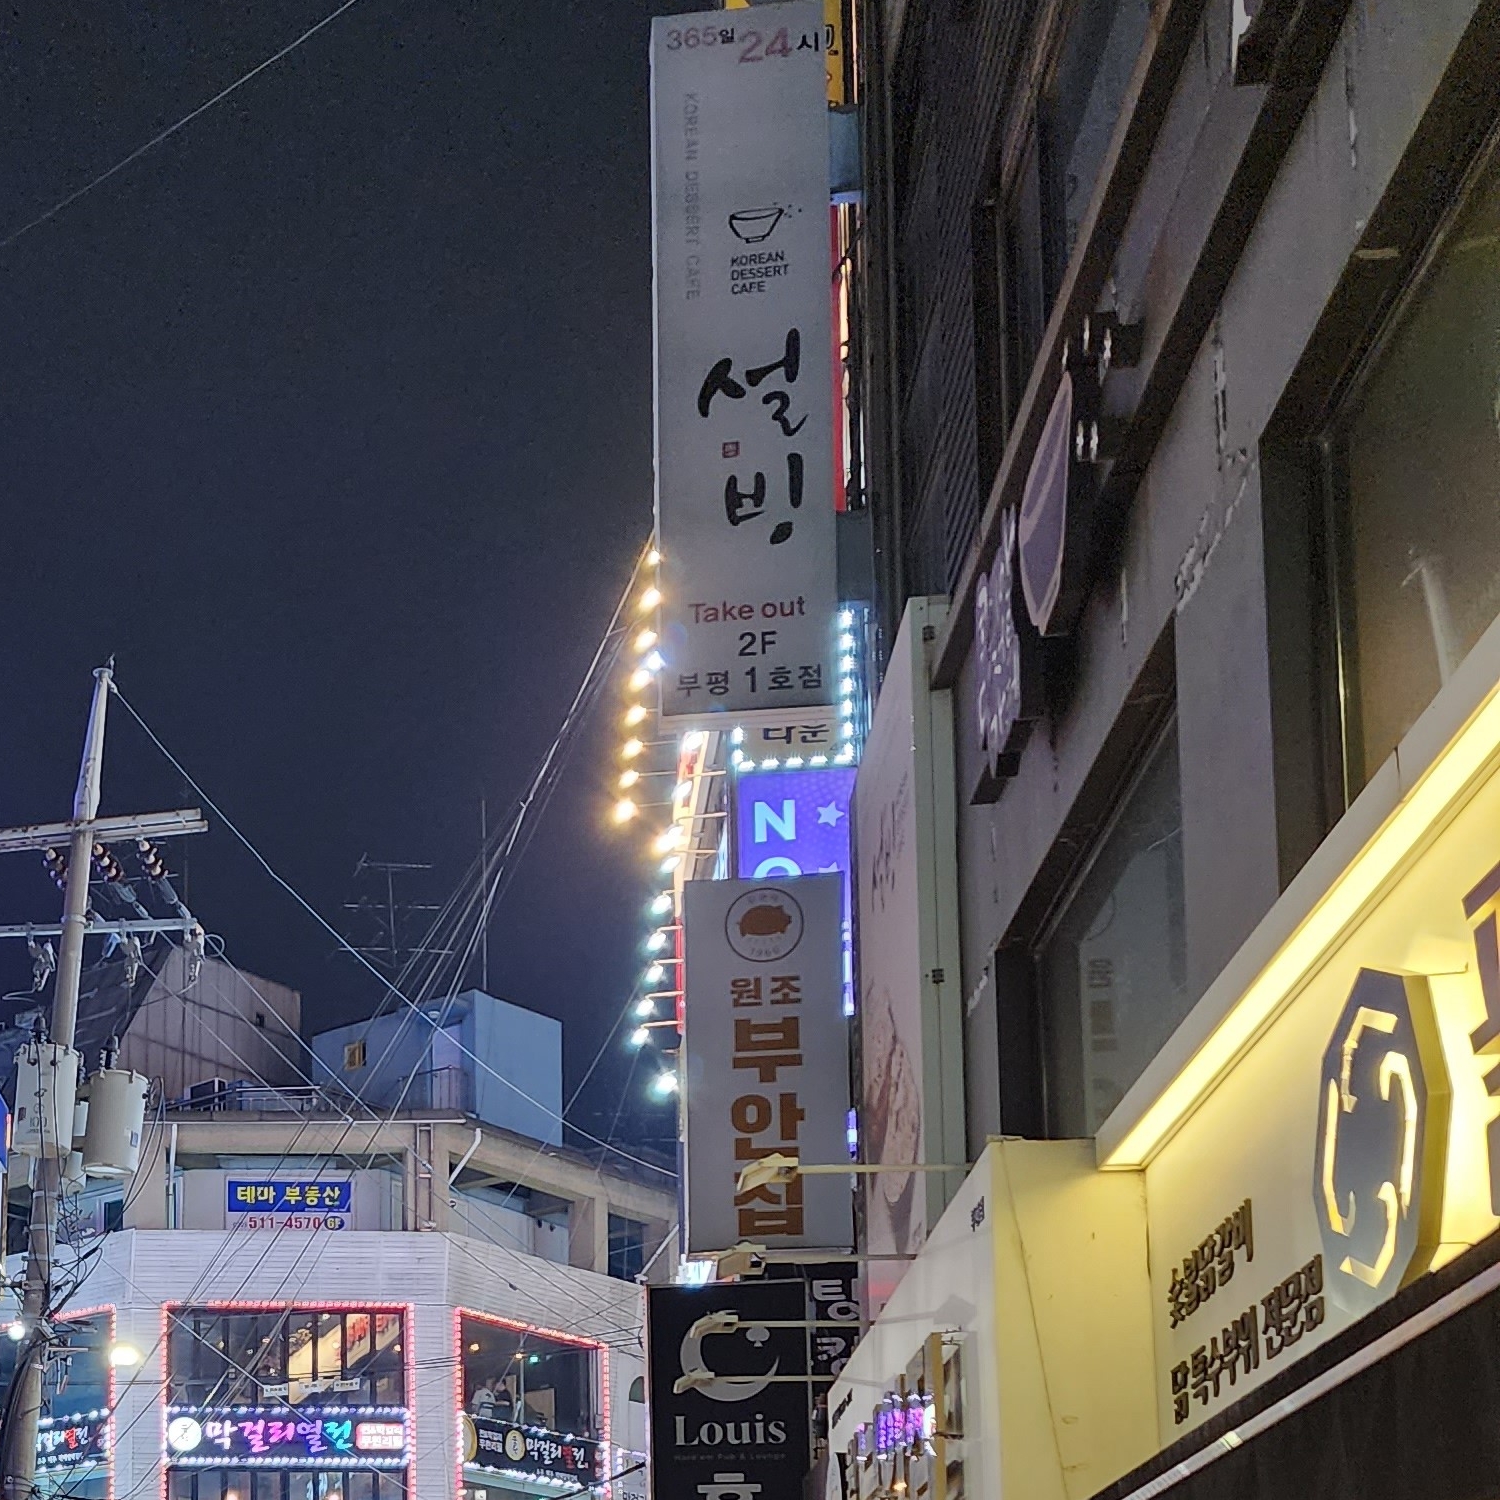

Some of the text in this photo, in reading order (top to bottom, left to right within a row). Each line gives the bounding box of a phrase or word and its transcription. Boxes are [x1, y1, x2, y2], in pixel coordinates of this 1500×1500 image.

[683, 93, 701, 301] KOREAN DESSERT CAFE
[730, 250, 786, 267] KOREAN
[731, 264, 790, 282] DESSERT
[731, 281, 767, 296] CAFE
[698, 328, 810, 546] 설빙
[688, 596, 806, 626] Take out
[737, 631, 779, 658] 2F
[676, 672, 730, 698] 부평
[730, 975, 804, 1008] 원조
[236, 1185, 341, 1206] 테마 부동산
[248, 1216, 321, 1230] 511-4570
[205, 1419, 354, 1454] 막걸리열전
[673, 1412, 788, 1448] Louis
